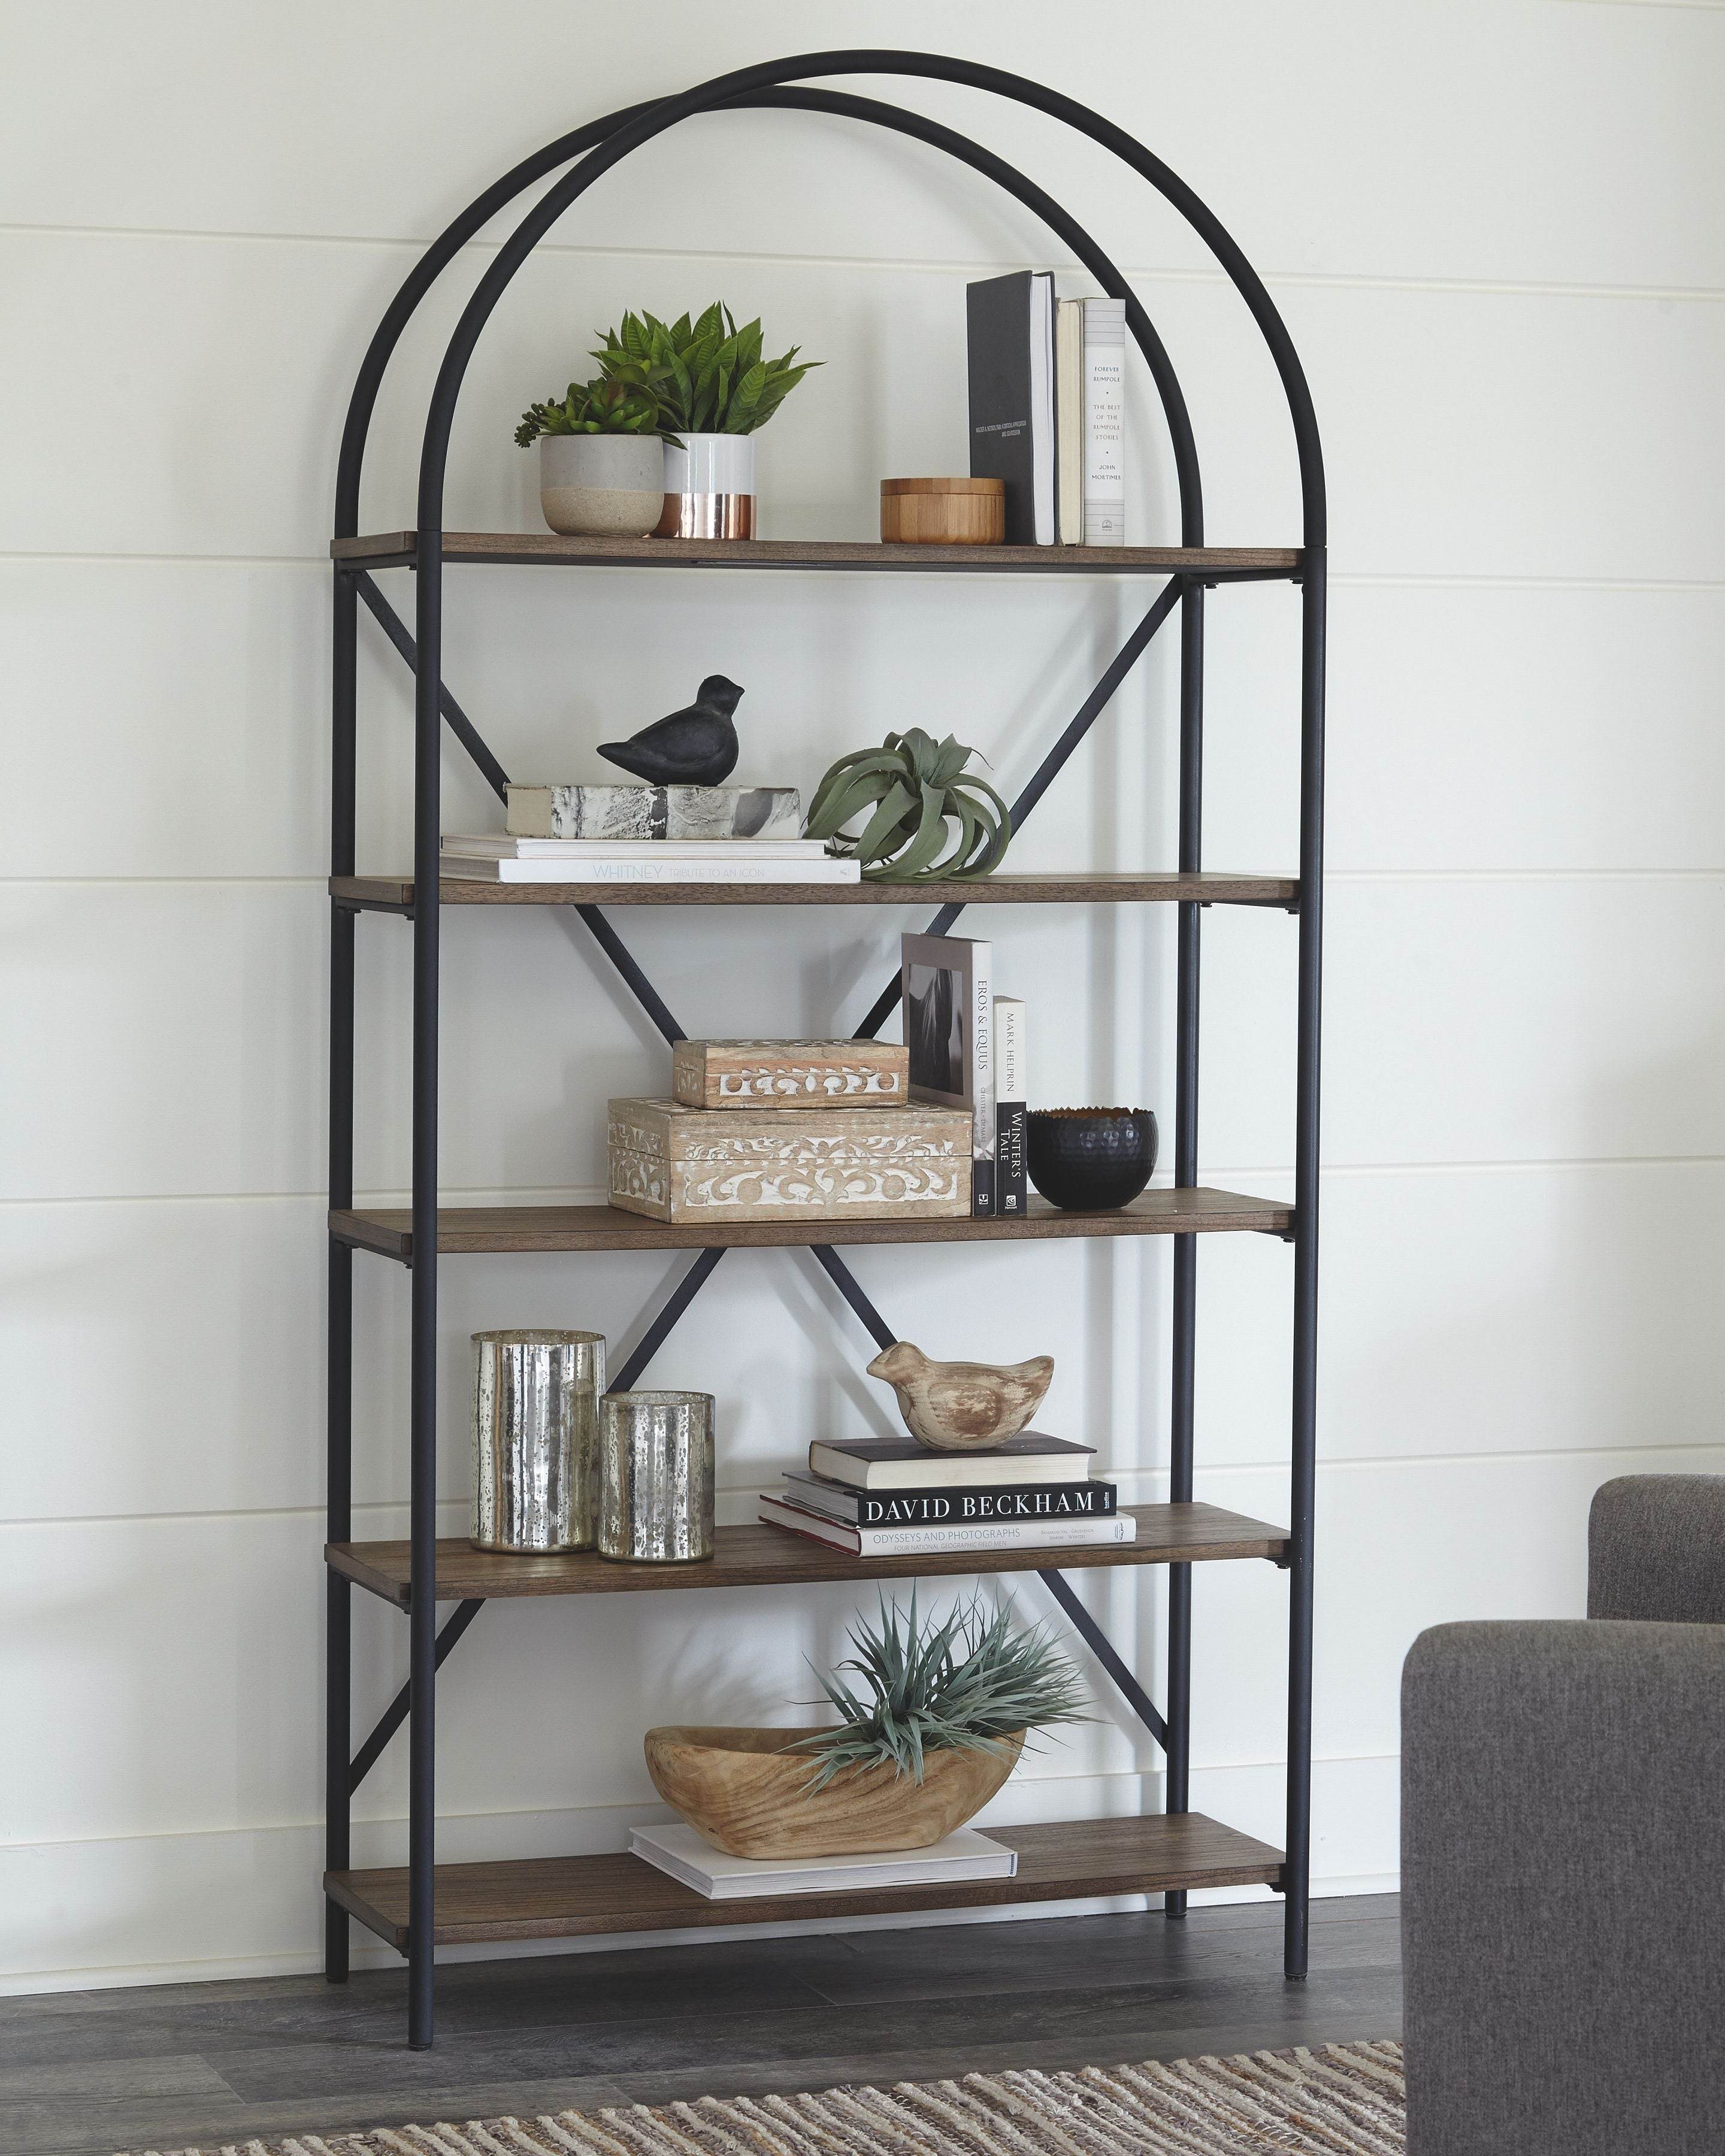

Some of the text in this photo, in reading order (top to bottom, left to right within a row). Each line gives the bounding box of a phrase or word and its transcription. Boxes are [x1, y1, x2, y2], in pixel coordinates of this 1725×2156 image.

[592, 865, 765, 879] WHITNEY TRIBUTE TO AN ICON
[976, 980, 988, 1070] EROS & EQUUS
[1006, 1013, 1015, 1092] MARK HELPRIN
[1001, 1129, 1010, 1161] TALE
[1011, 1112, 1022, 1178] WINTER'S
[866, 1491, 1094, 1521] DAVID BECKHAM
[873, 1528, 1021, 1544] ODYSSEYS AND PHOTOGRAPHS
